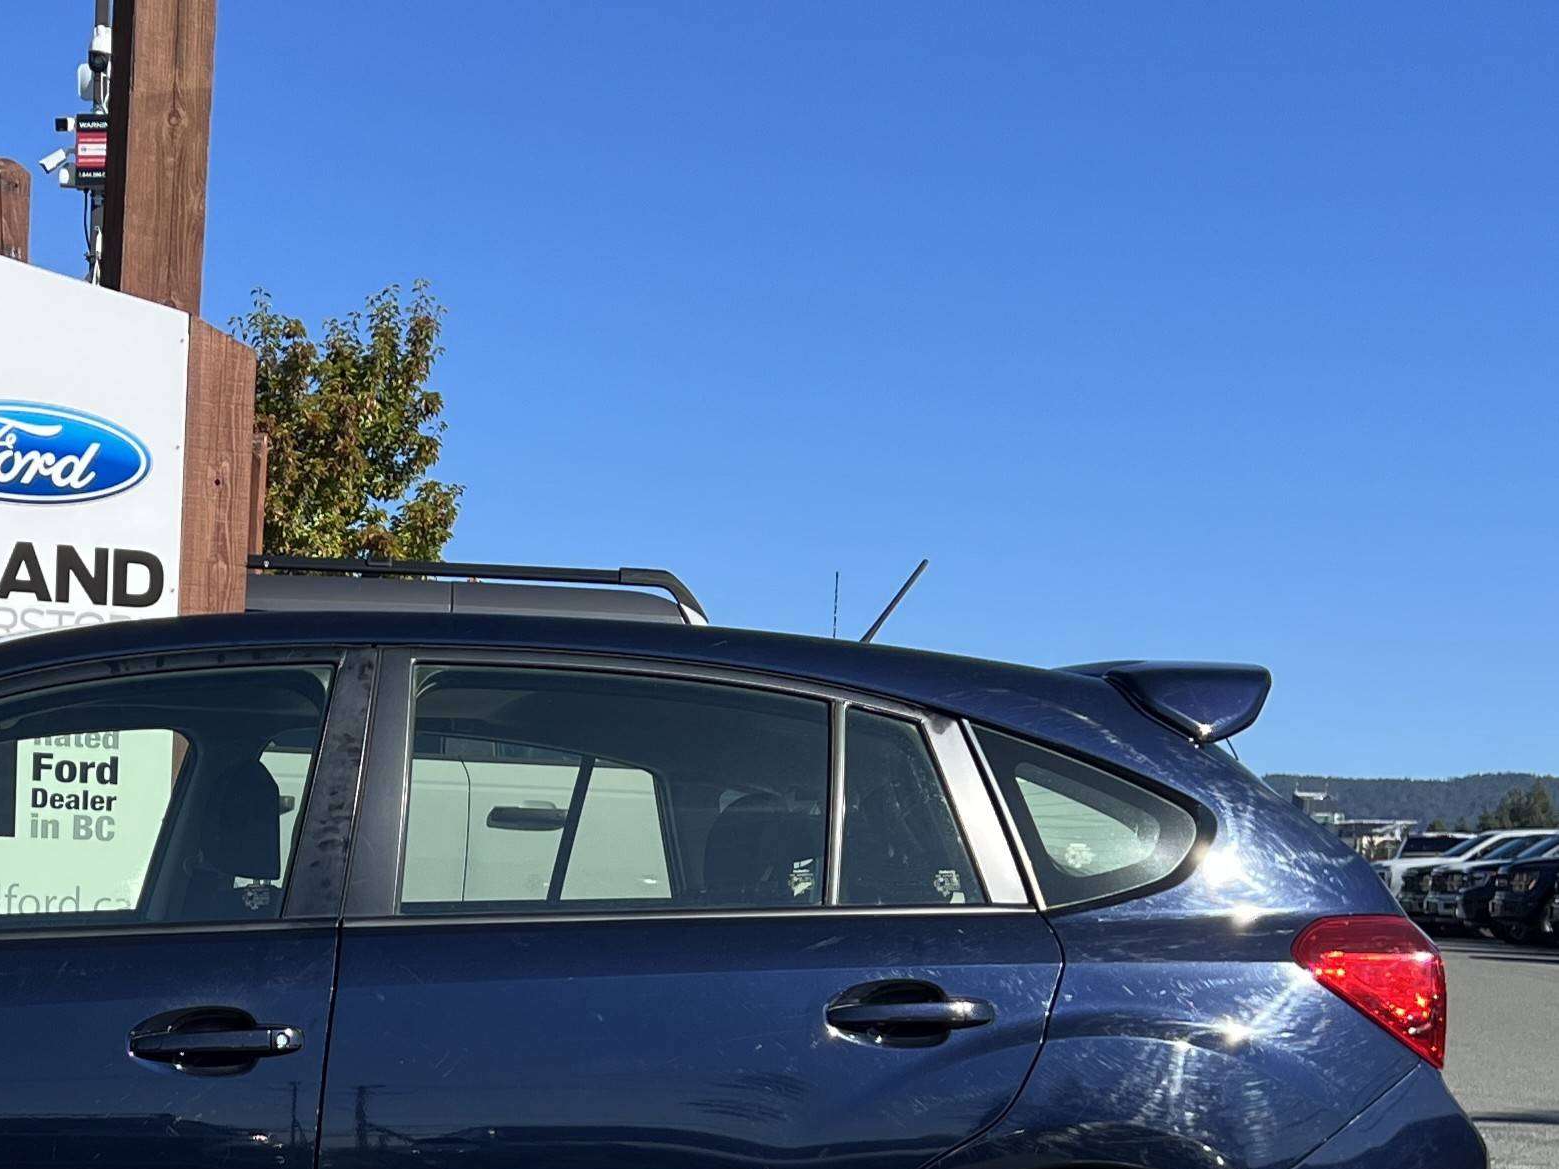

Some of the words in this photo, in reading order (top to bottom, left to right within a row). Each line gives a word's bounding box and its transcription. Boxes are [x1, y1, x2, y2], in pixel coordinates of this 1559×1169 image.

[32, 752, 119, 785] Ford
[31, 788, 118, 812] Dealer
[30, 813, 60, 840] in
[72, 814, 116, 842] BC
